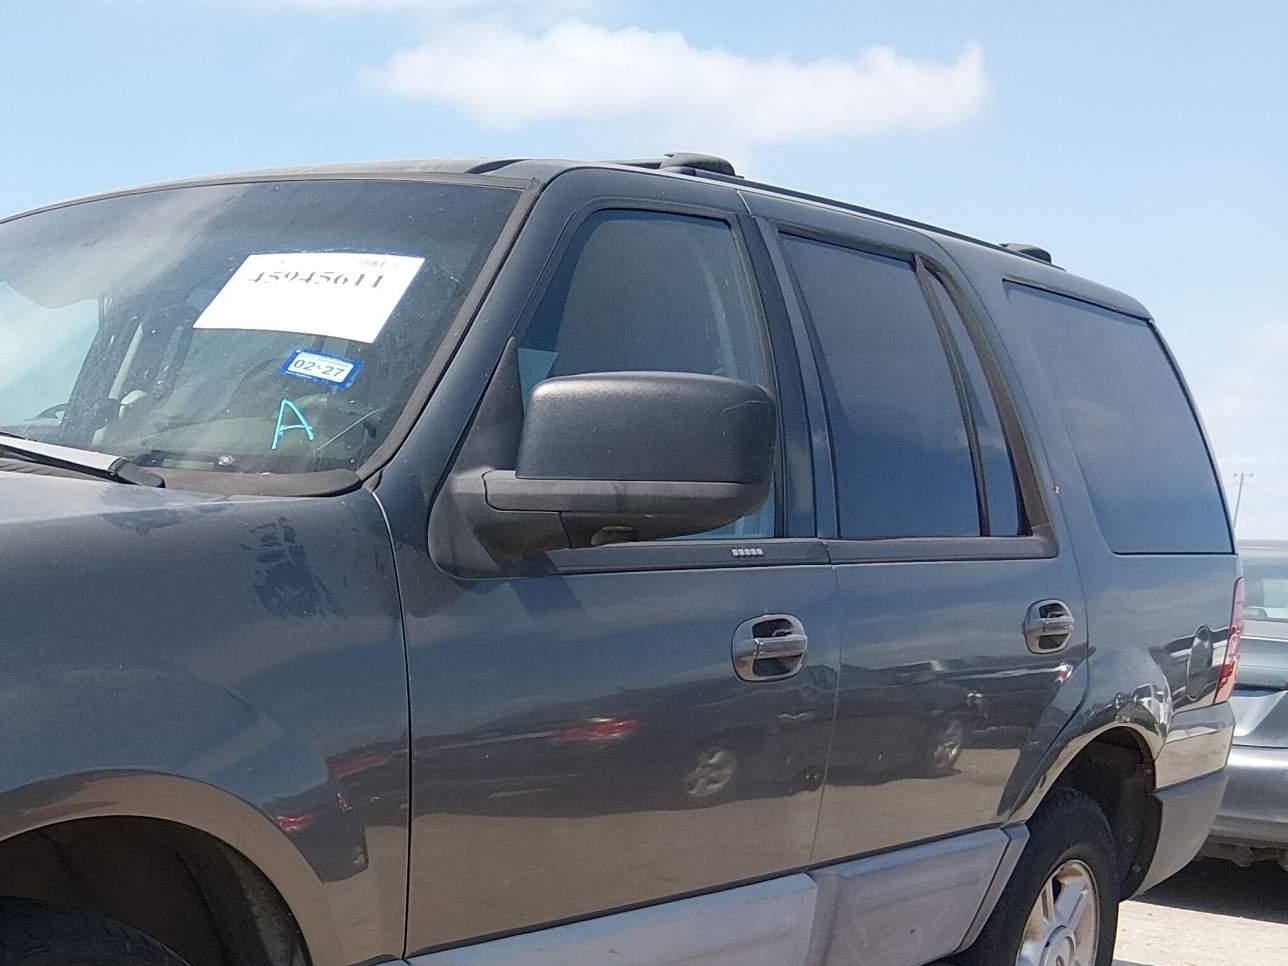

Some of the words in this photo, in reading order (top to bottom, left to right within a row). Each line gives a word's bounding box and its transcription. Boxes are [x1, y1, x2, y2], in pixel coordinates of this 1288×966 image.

[294, 359, 316, 372] 02
[321, 365, 346, 377] 27
[271, 399, 313, 449] A
